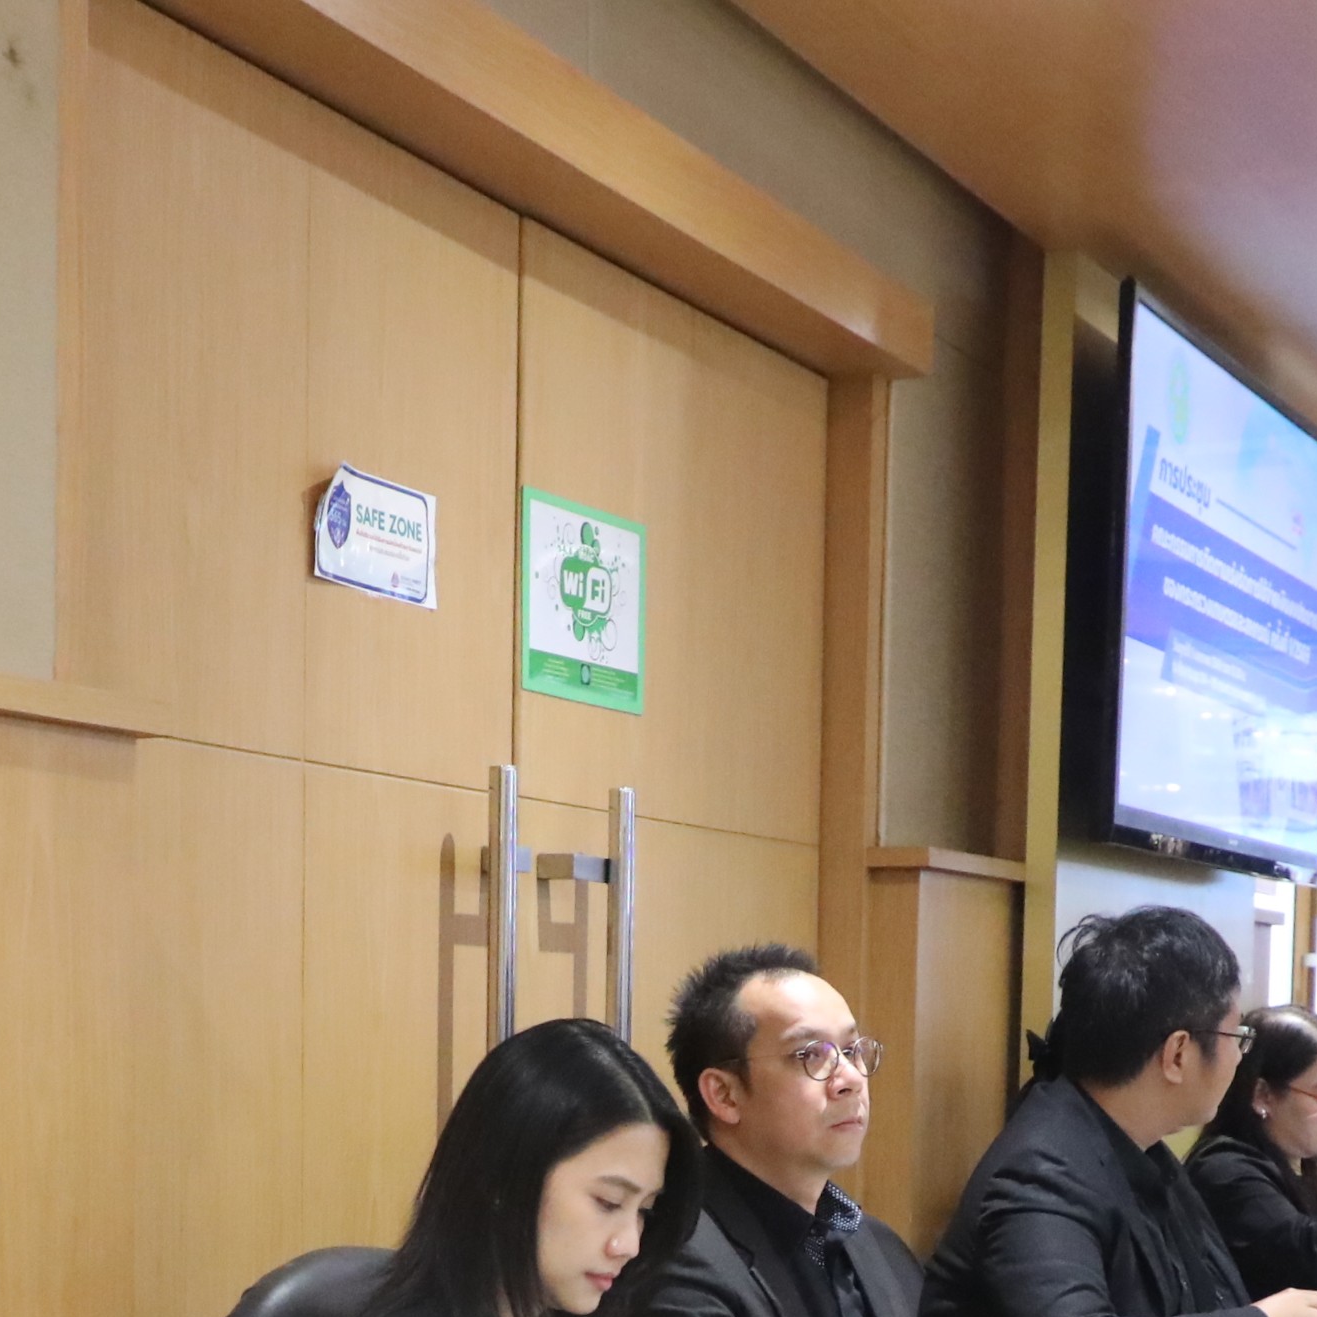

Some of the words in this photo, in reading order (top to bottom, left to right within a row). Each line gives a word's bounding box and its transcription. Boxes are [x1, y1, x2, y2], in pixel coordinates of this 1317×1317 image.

[1159, 458, 1211, 515] การประชุม
[356, 504, 385, 531] SAFE
[389, 514, 422, 542] ZONE
[577, 609, 592, 621] FREE
